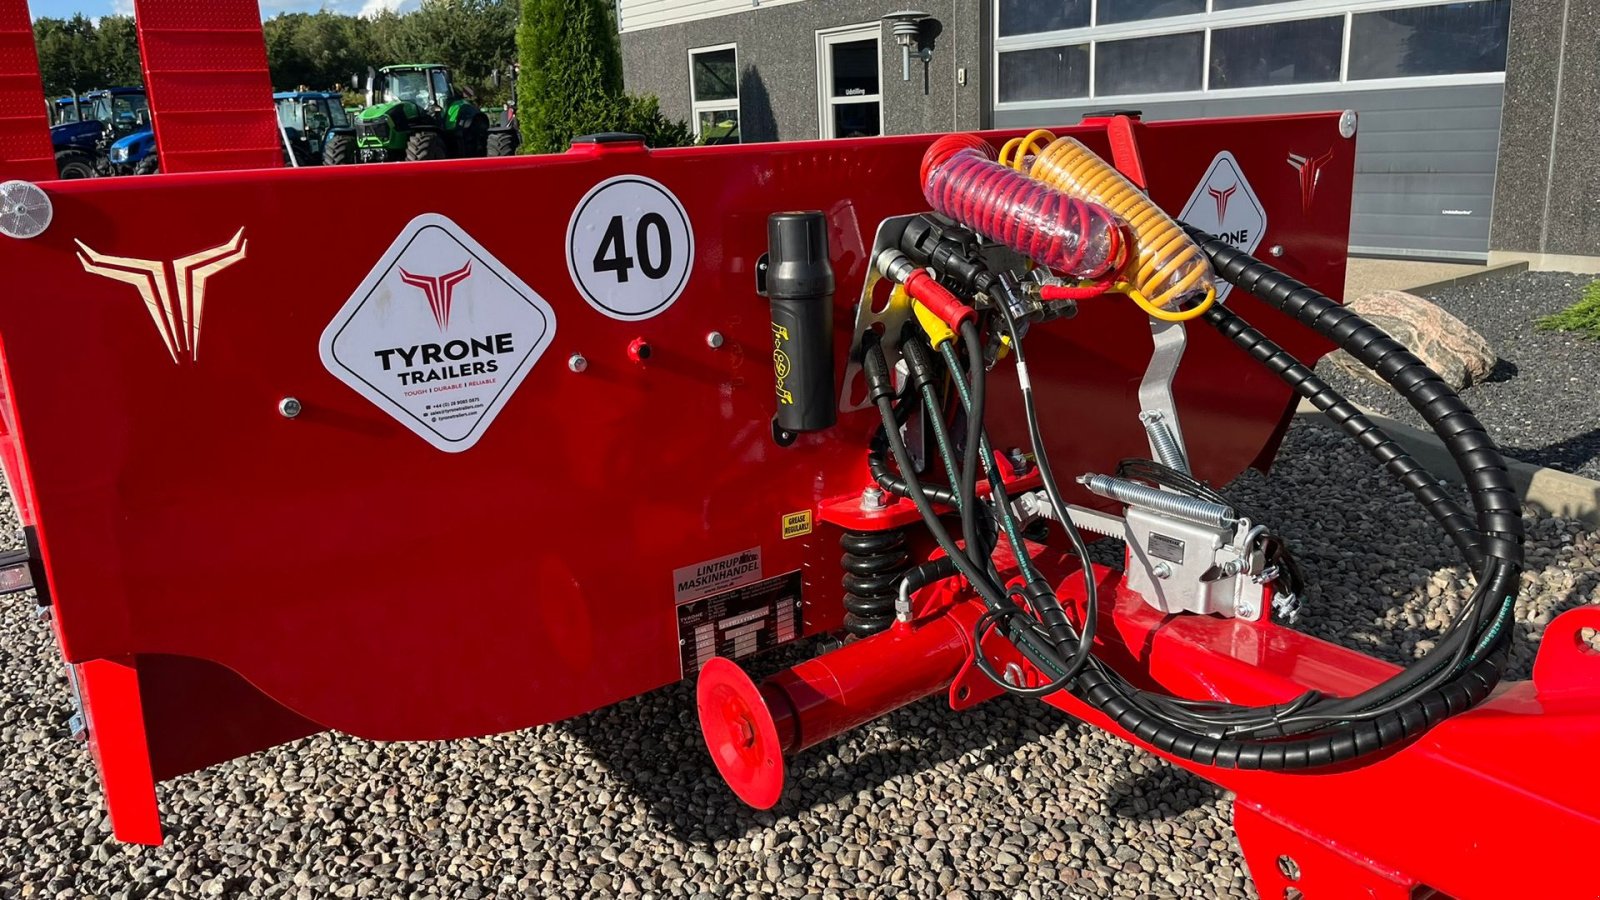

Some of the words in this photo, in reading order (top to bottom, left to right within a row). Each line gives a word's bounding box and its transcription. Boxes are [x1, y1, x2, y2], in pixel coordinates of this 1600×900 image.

[593, 212, 672, 283] 40
[374, 332, 514, 371] TYRONE
[397, 359, 499, 386] TRAILERS
[404, 389, 428, 397] TOUGH
[433, 383, 463, 392] DURABLE
[468, 378, 496, 387] RELIABLE
[785, 523, 809, 534] REGULARLY
[788, 515, 806, 525] GREASE
[678, 562, 759, 592] MASKINHANDEL
[697, 557, 739, 577] LINTRUP
